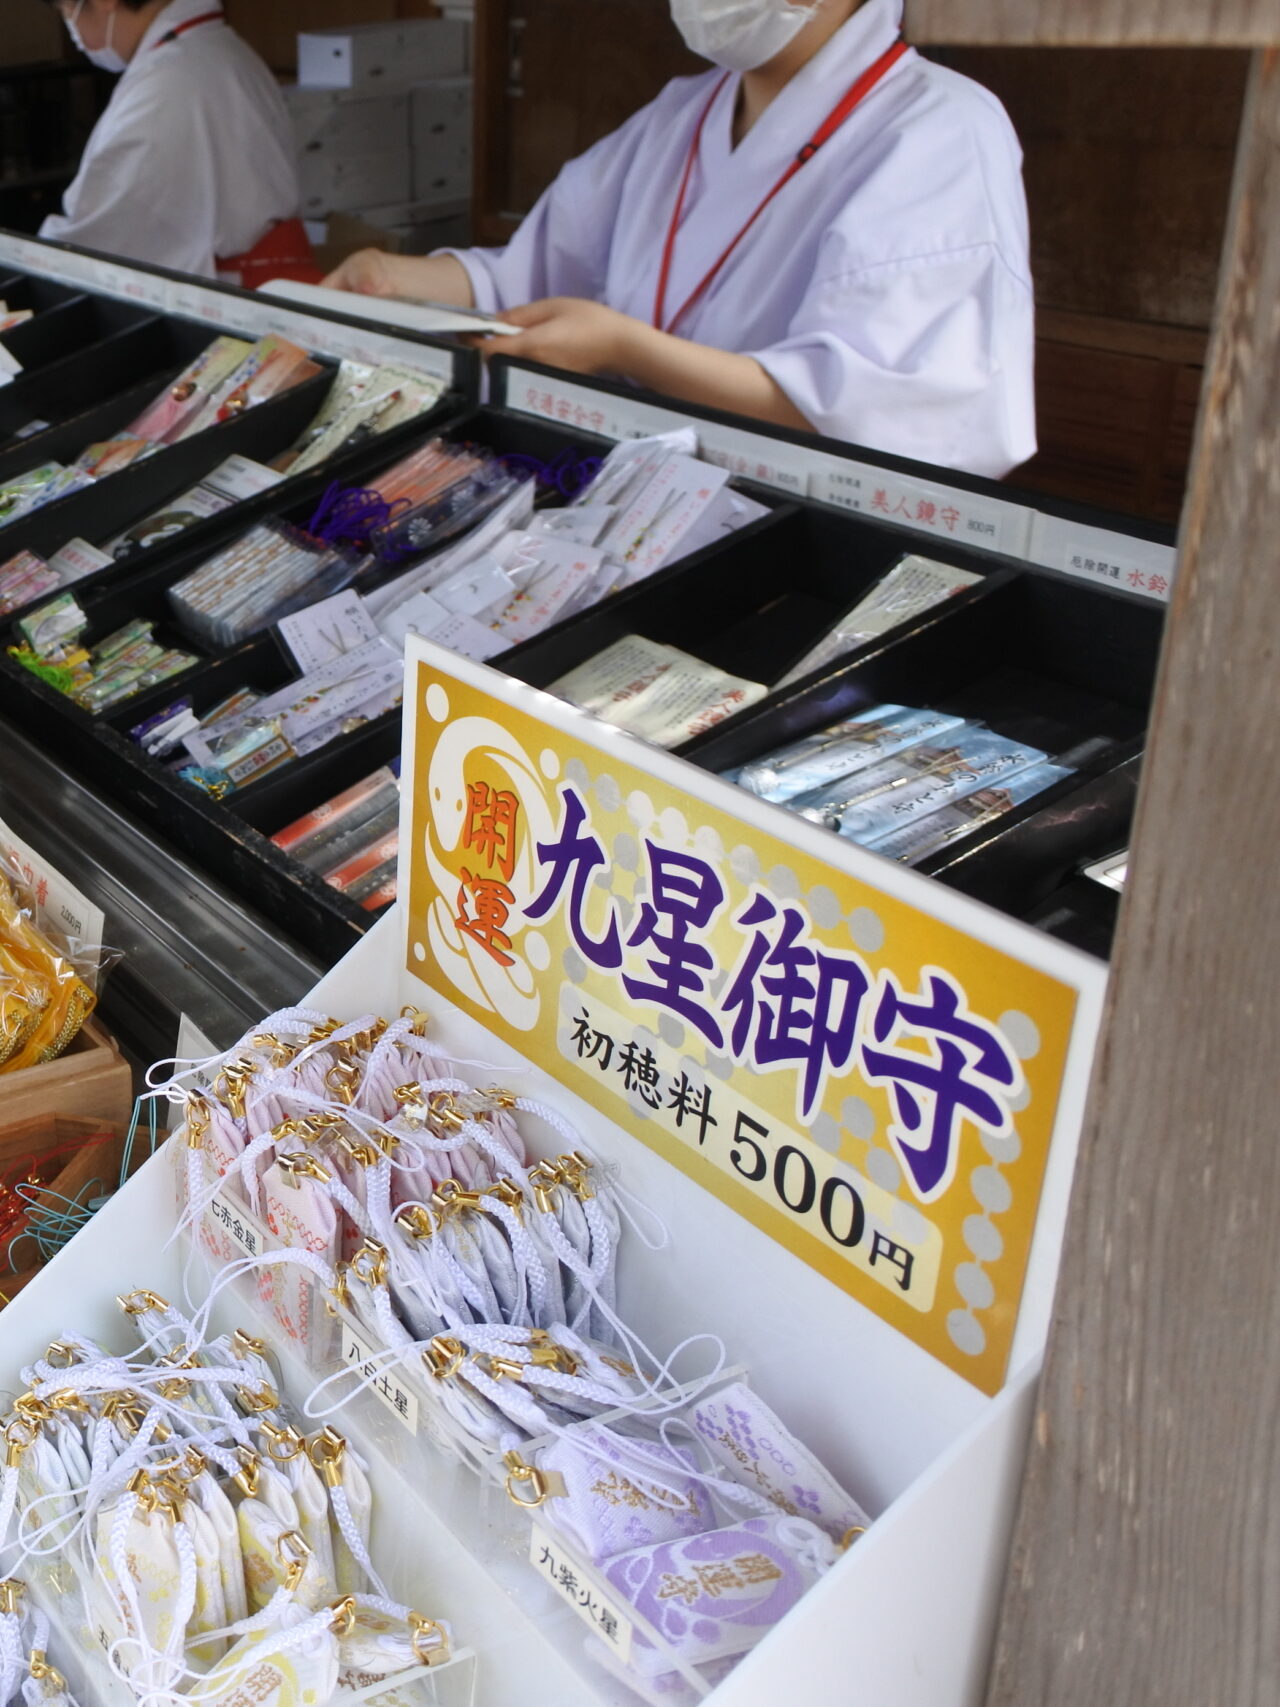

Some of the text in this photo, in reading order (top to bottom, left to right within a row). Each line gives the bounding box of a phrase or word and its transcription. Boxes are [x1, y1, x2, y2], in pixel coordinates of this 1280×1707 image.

[870, 487, 961, 532] 美人鏡守
[1070, 555, 1169, 595] 厄除開運 水鈴
[455, 780, 520, 967] 開運
[522, 786, 1018, 1195] 九星御守
[568, 1005, 915, 1293] 初穂料 500円
[210, 1198, 257, 1258] 七赤金星
[539, 1545, 620, 1646] 九紫火星
[656, 1552, 783, 1606] 開運守
